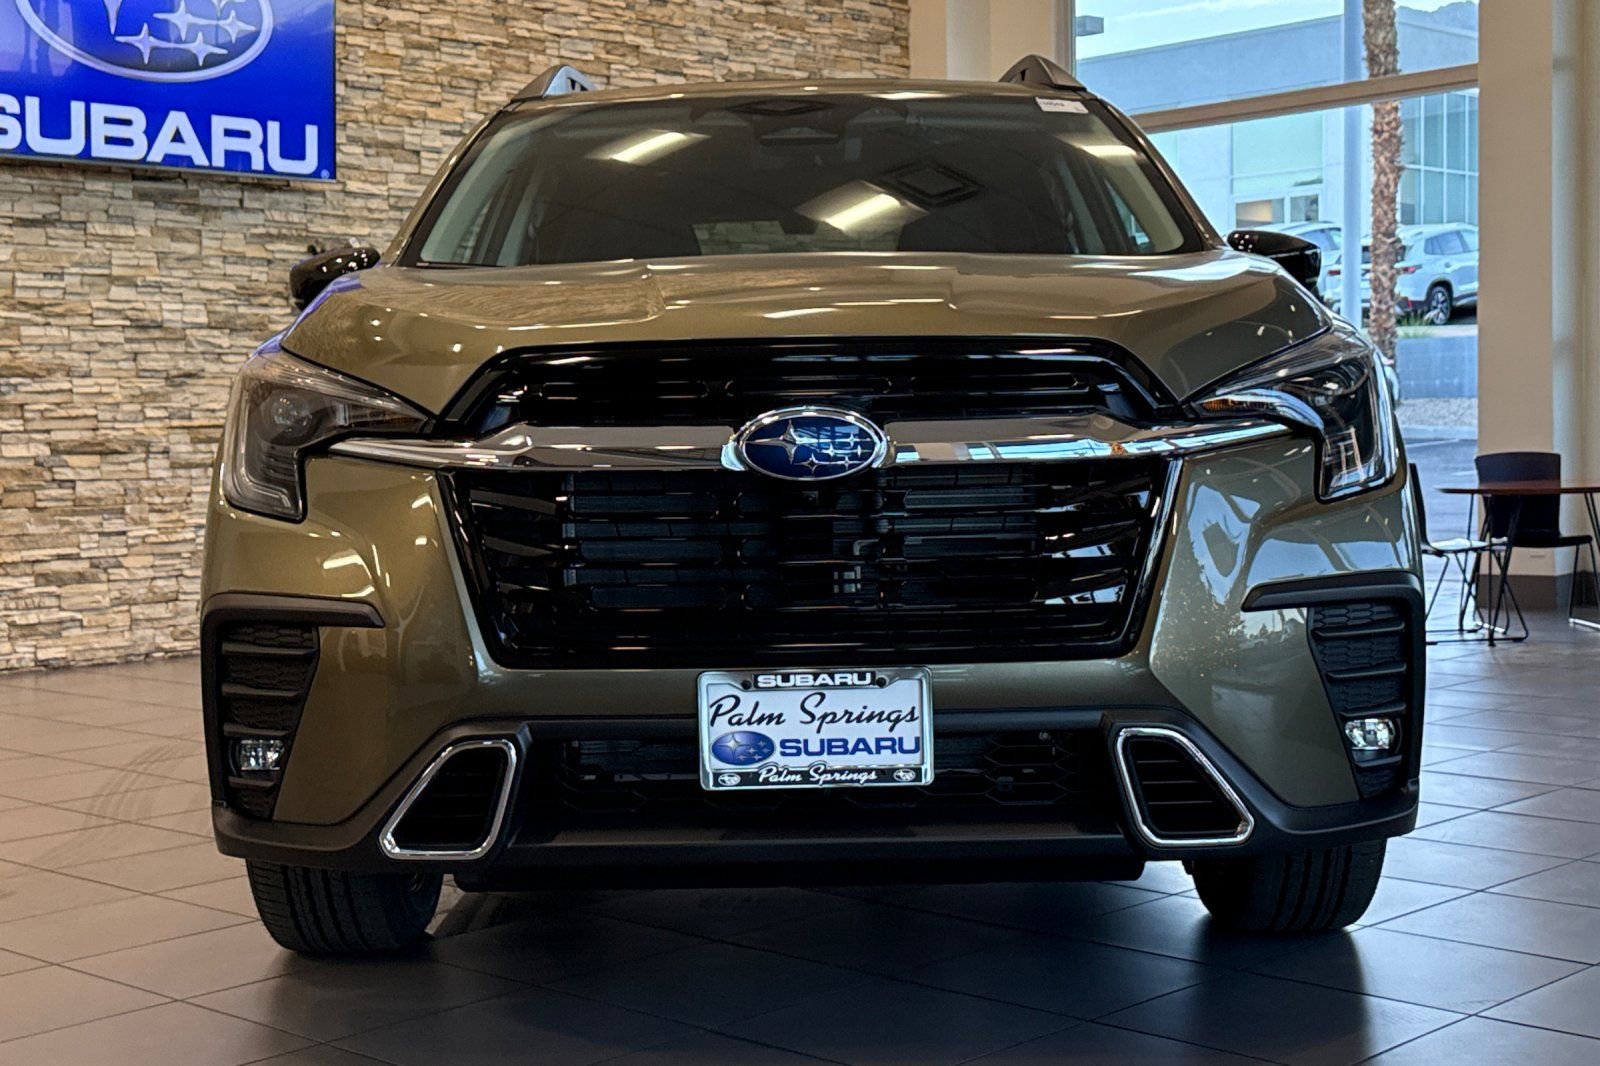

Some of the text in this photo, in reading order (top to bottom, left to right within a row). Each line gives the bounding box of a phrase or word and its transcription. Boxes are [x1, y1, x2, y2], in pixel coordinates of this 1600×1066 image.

[757, 673, 871, 687] SUBARU
[710, 692, 919, 733] Palm Springs
[779, 737, 920, 756] SUBARU
[758, 763, 877, 784] Palm Springs
